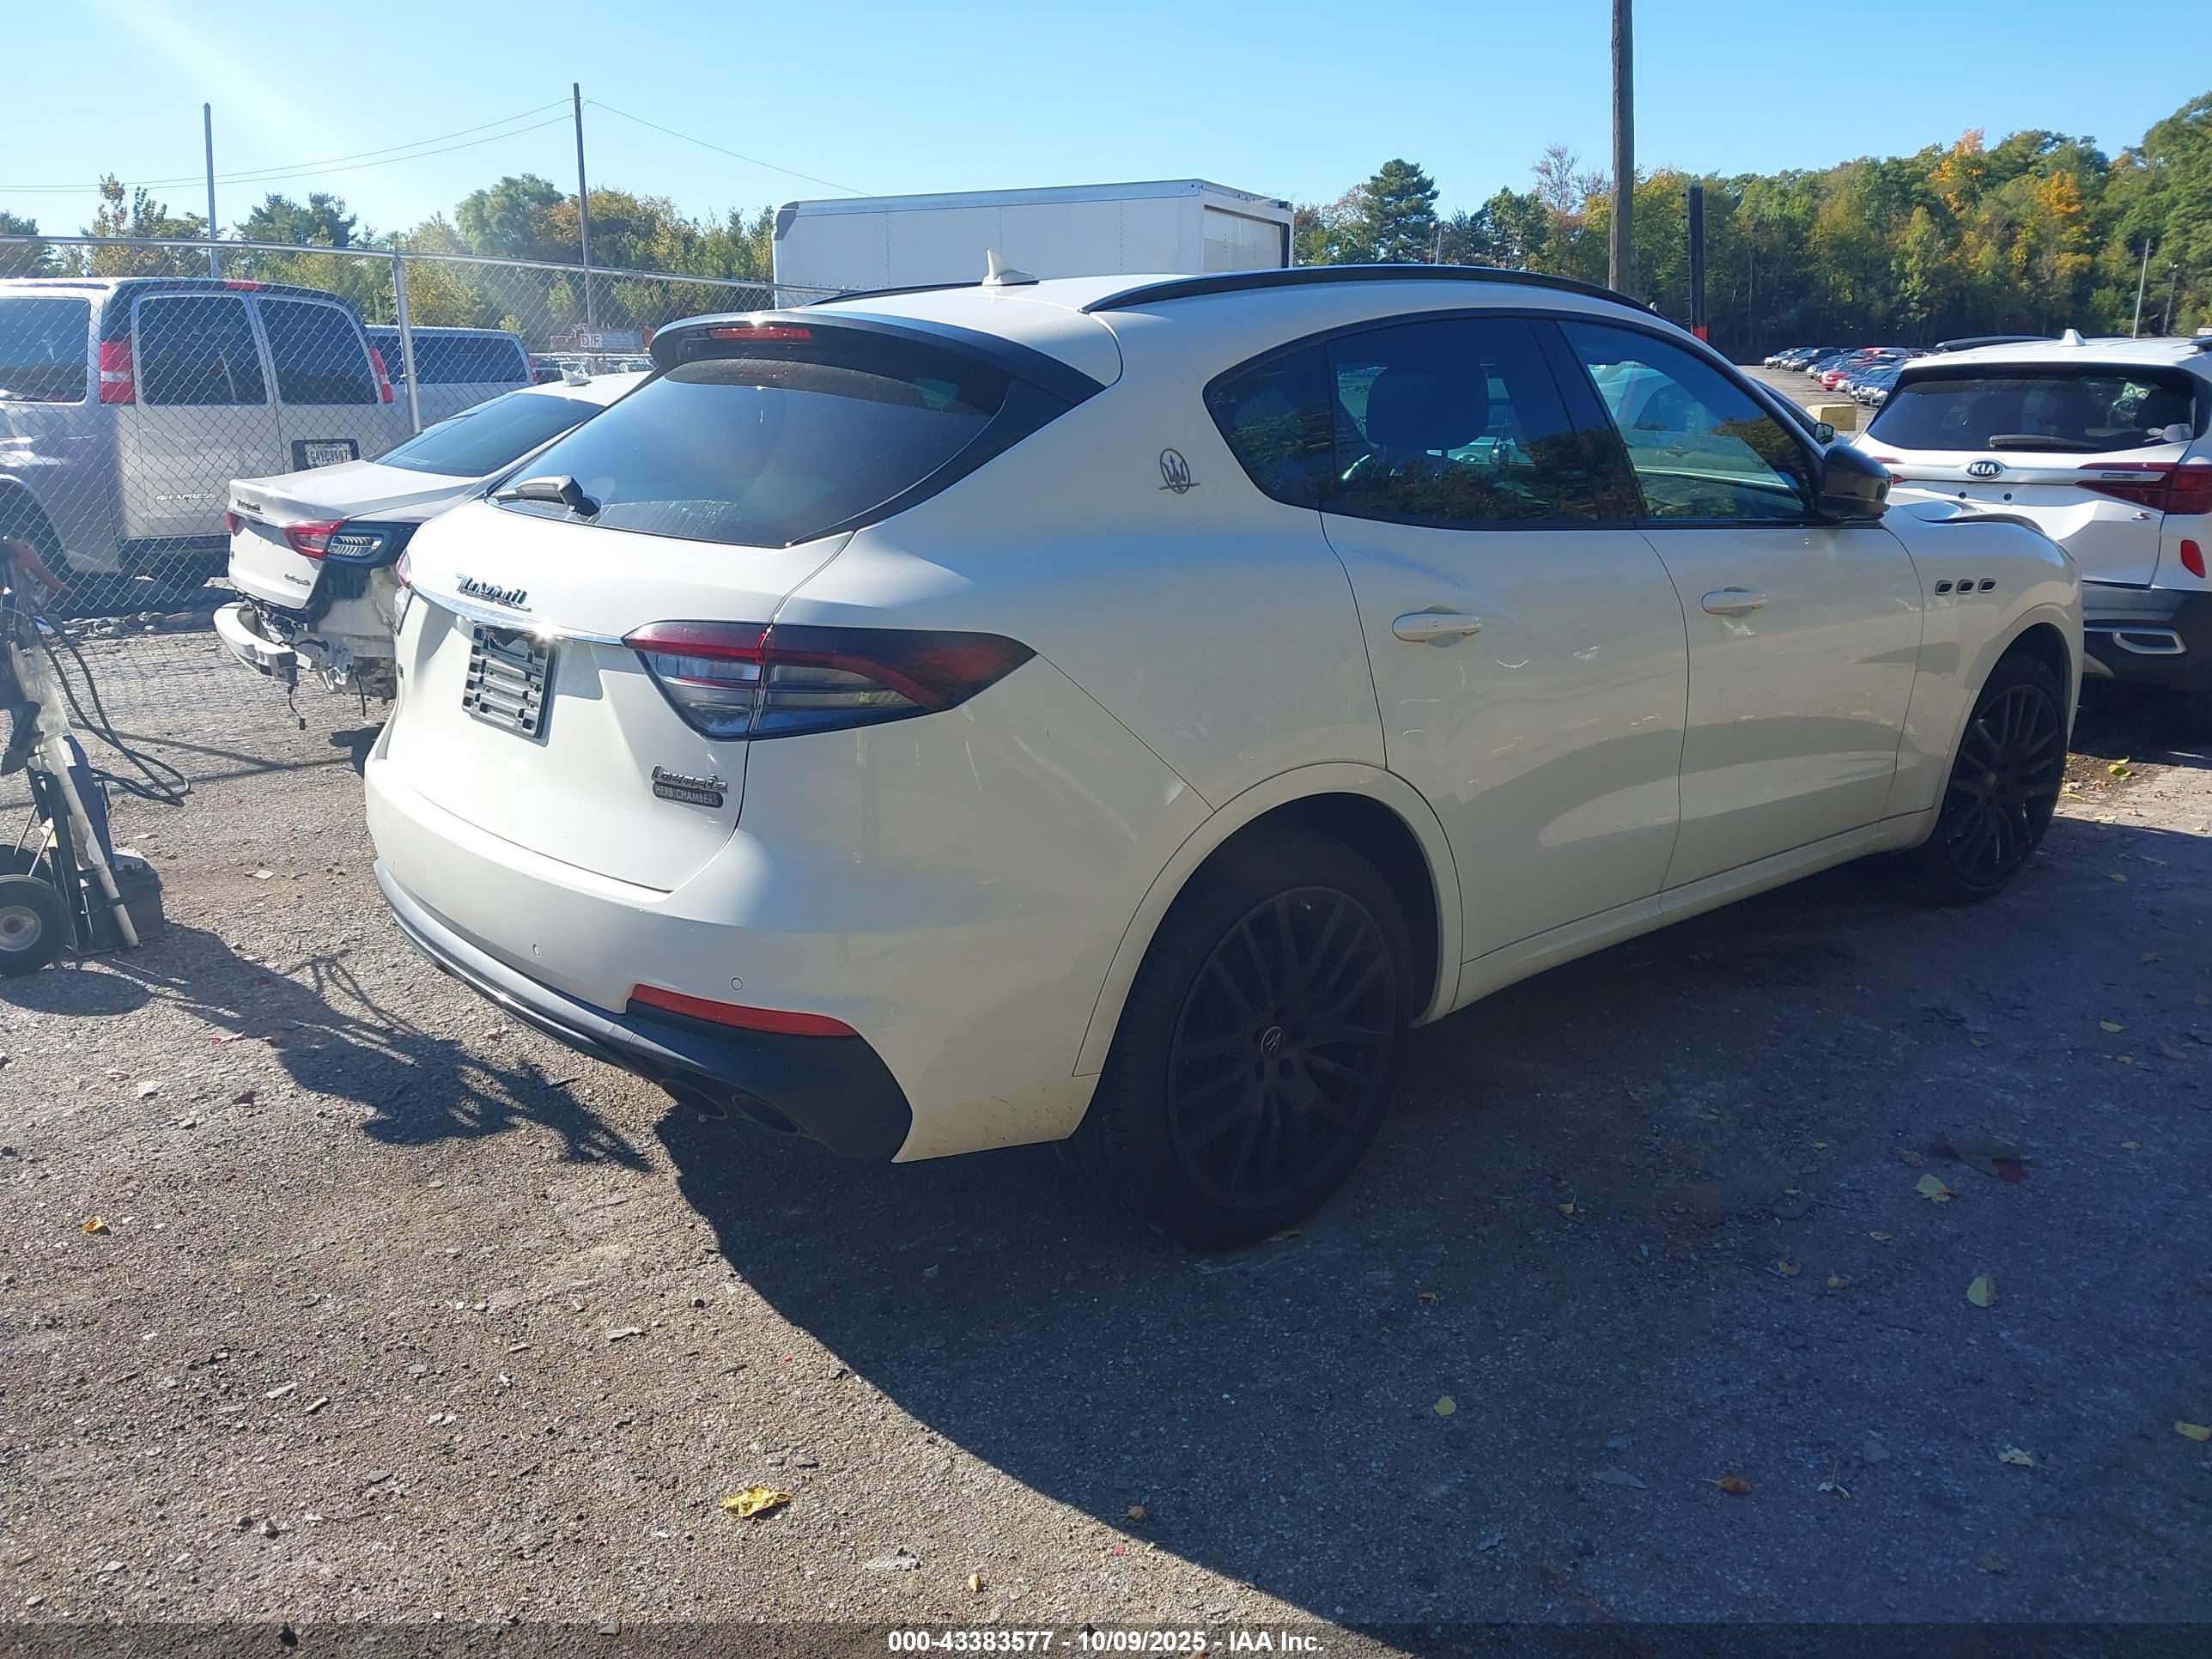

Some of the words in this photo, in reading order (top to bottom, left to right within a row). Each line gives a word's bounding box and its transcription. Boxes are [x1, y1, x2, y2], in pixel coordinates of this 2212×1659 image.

[1971, 464, 1996, 474] KIA
[655, 785, 674, 798] HERB
[677, 789, 719, 805] CHAMBERS
